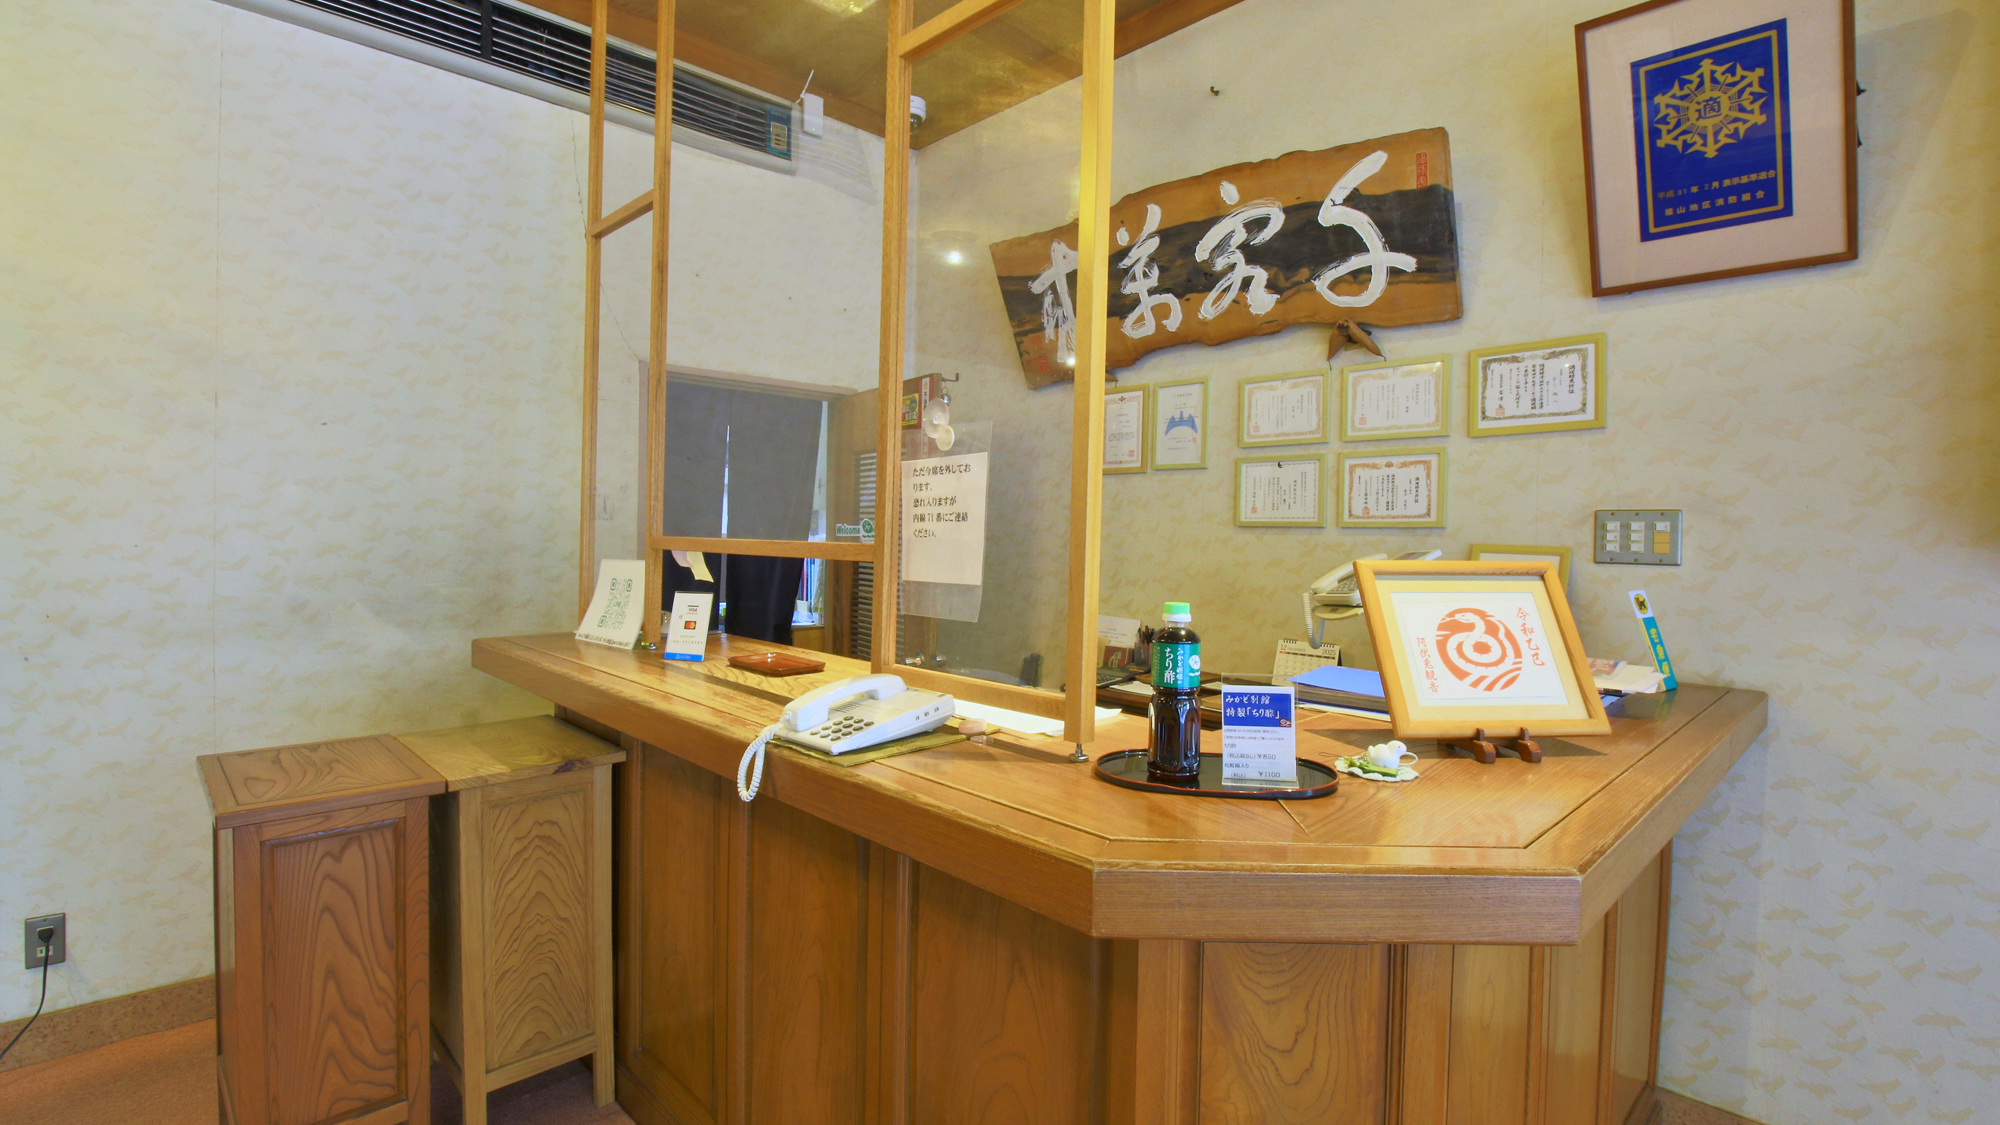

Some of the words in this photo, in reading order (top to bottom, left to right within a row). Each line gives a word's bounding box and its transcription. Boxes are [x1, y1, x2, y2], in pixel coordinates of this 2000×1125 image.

[1695, 96, 1722, 122] 適
[912, 463, 971, 477] ただ今席を外してお
[912, 482, 933, 492] ります。
[912, 496, 957, 508] 恐れ入りますが
[836, 525, 861, 535] Welcome
[913, 528, 937, 538] ください。
[1649, 627, 1671, 677] 宅急便
[1164, 646, 1175, 684] ちり酢
[1225, 694, 1271, 705] みかど別館
[1225, 706, 1280, 719] 特製「ちり酢」
